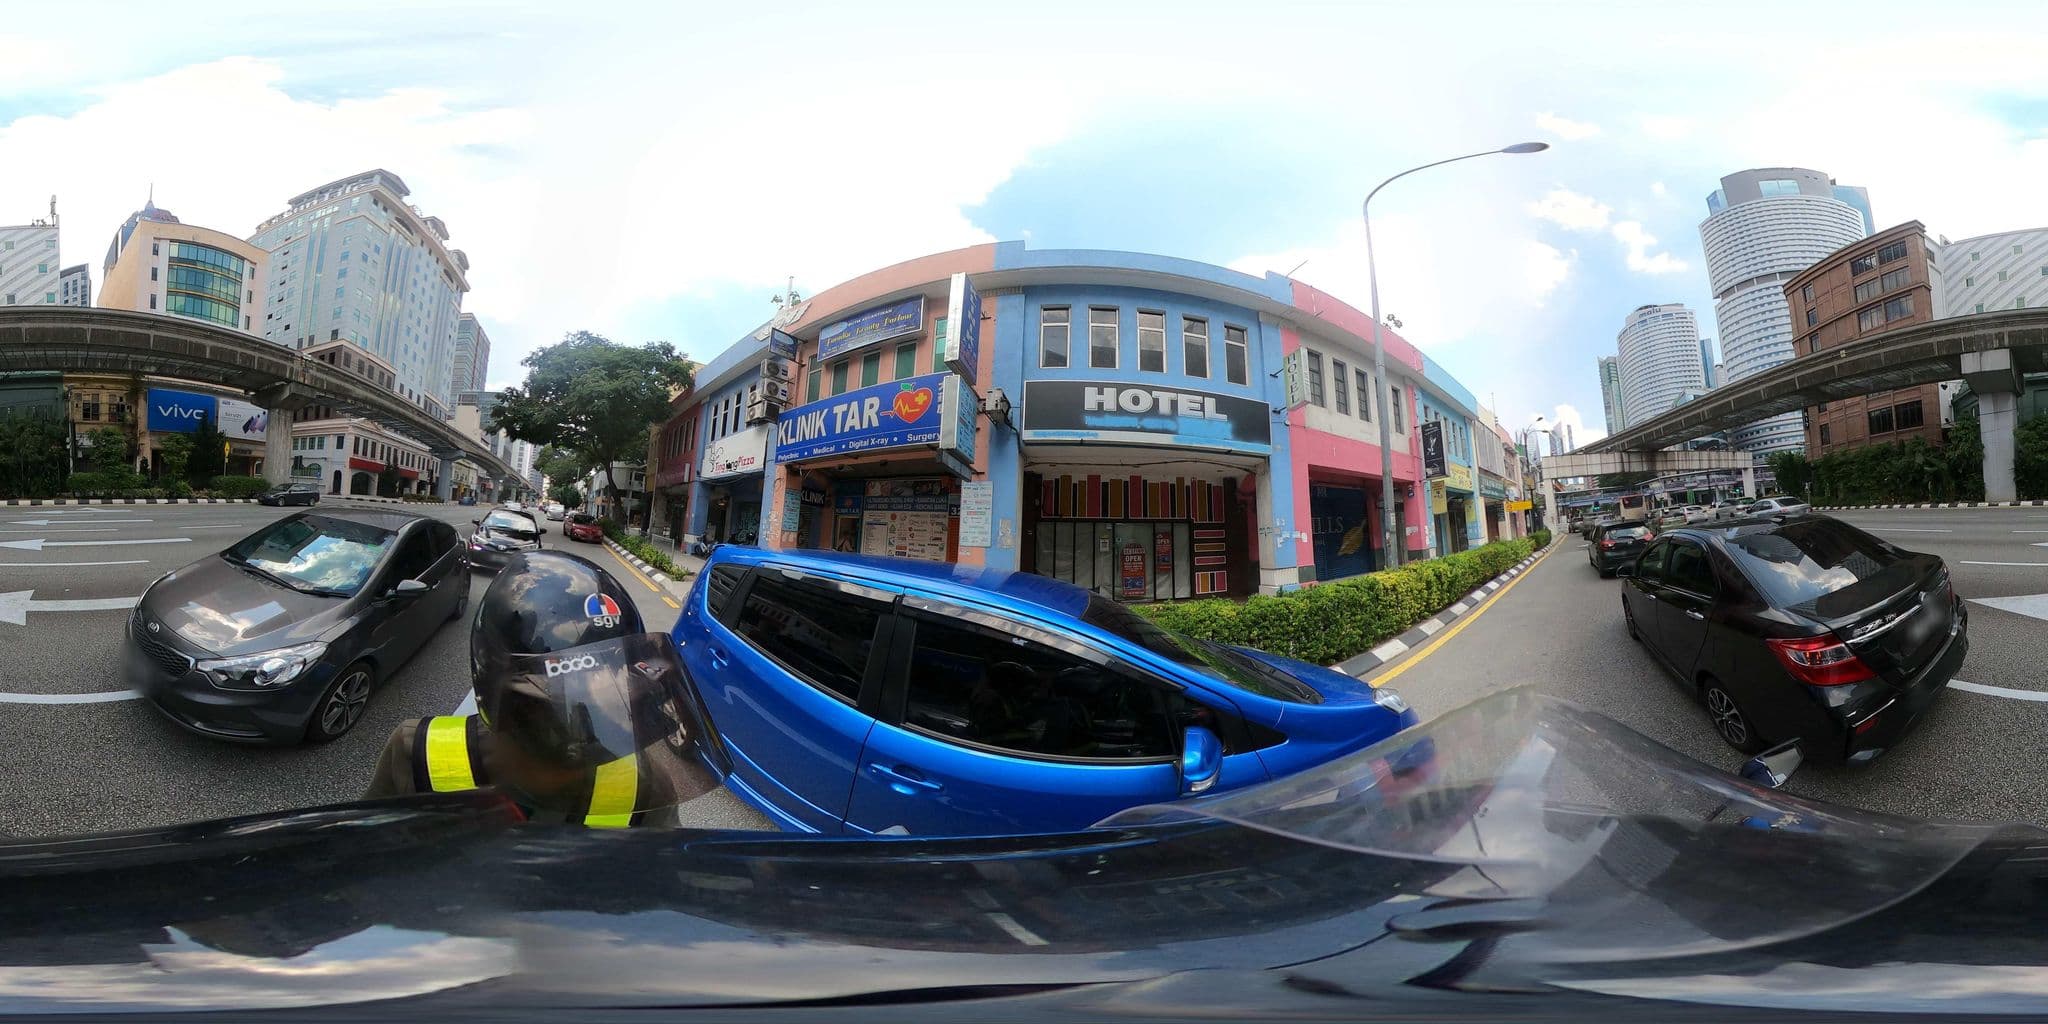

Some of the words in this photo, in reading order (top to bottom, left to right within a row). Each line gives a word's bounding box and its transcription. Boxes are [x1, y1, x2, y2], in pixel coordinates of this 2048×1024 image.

[1287, 353, 1301, 404] HOTEL
[777, 408, 829, 447] KLINIK
[833, 396, 880, 434] TAR
[1084, 386, 1228, 422] HOTEL
[813, 445, 836, 455] Medical
[849, 439, 870, 449] Digital
[870, 436, 889, 447] X-ray
[906, 431, 942, 442] Surgery
[593, 614, 621, 628] sgv
